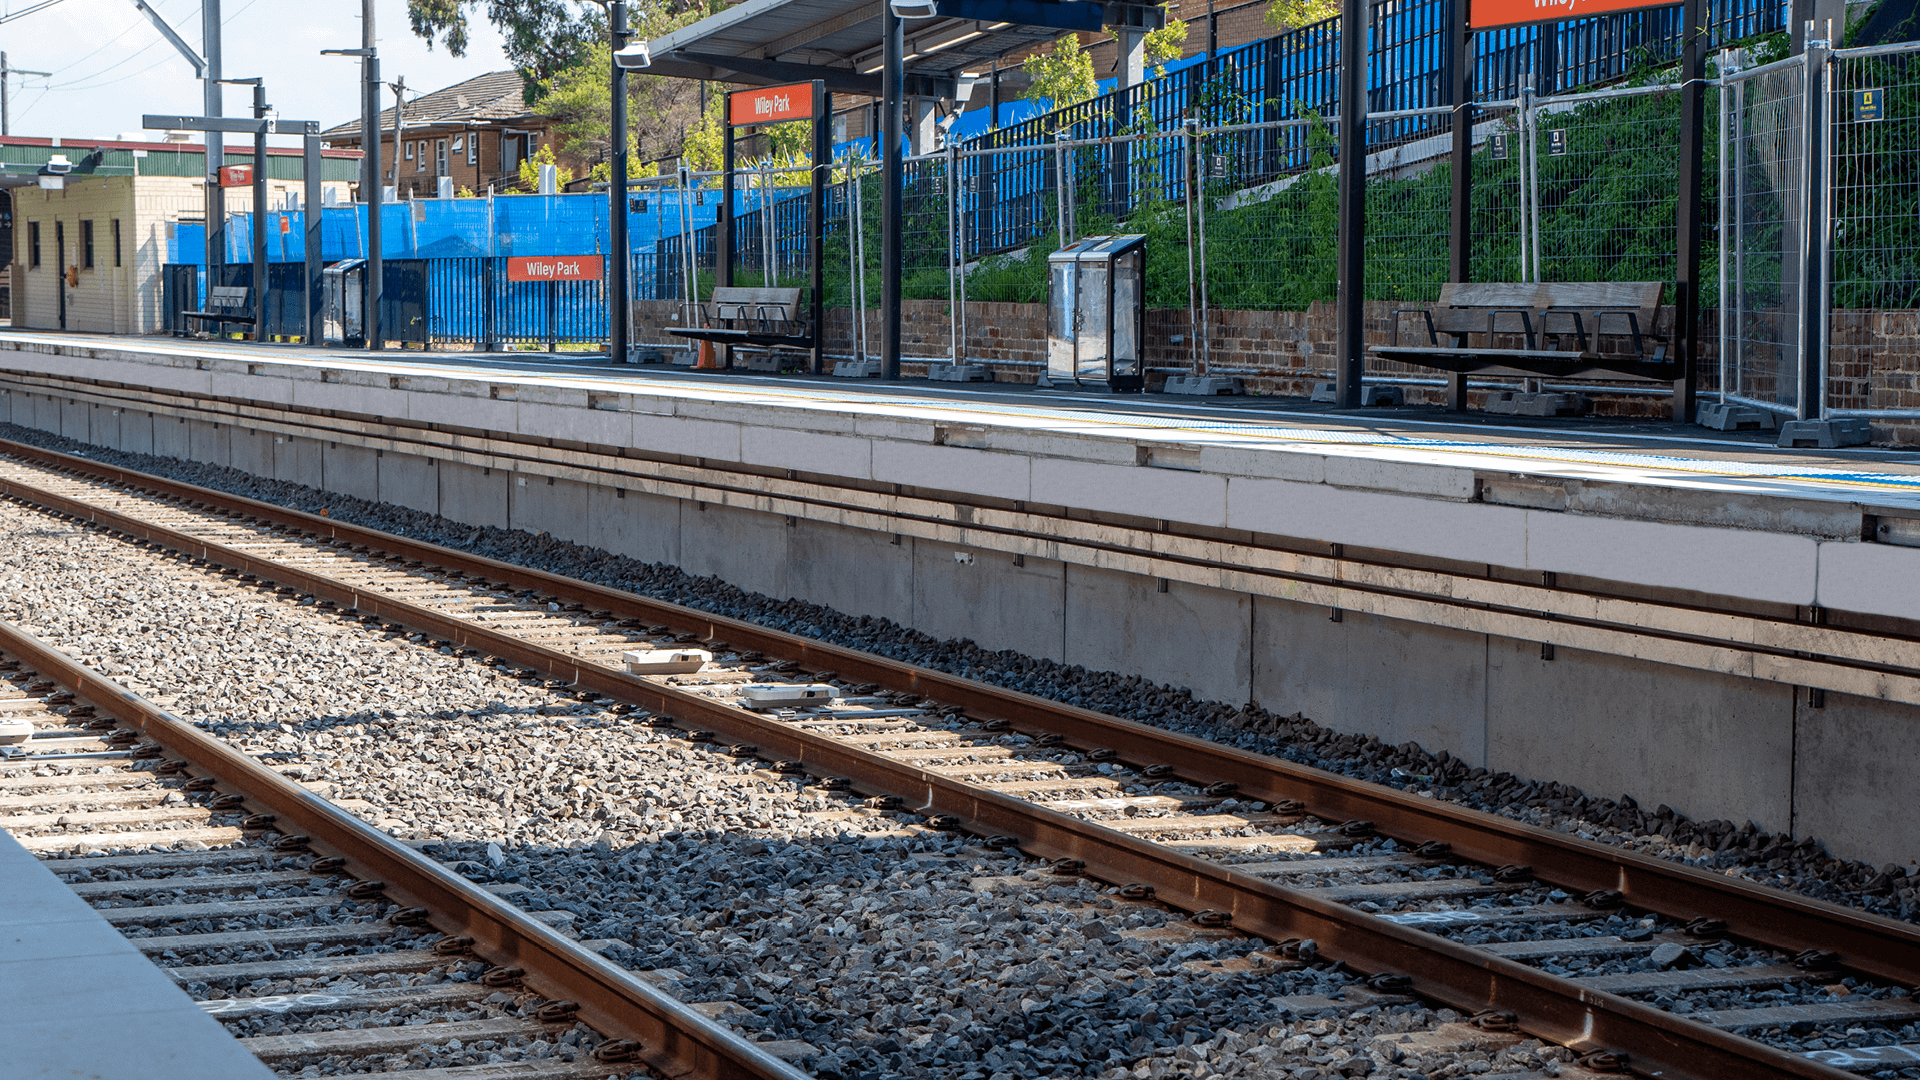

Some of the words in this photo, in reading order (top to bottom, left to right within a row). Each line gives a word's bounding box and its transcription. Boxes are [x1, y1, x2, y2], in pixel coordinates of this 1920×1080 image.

[754, 96, 773, 117] Wiley
[774, 94, 789, 112] Park
[526, 261, 555, 278] Wiley
[557, 261, 580, 275] Park
